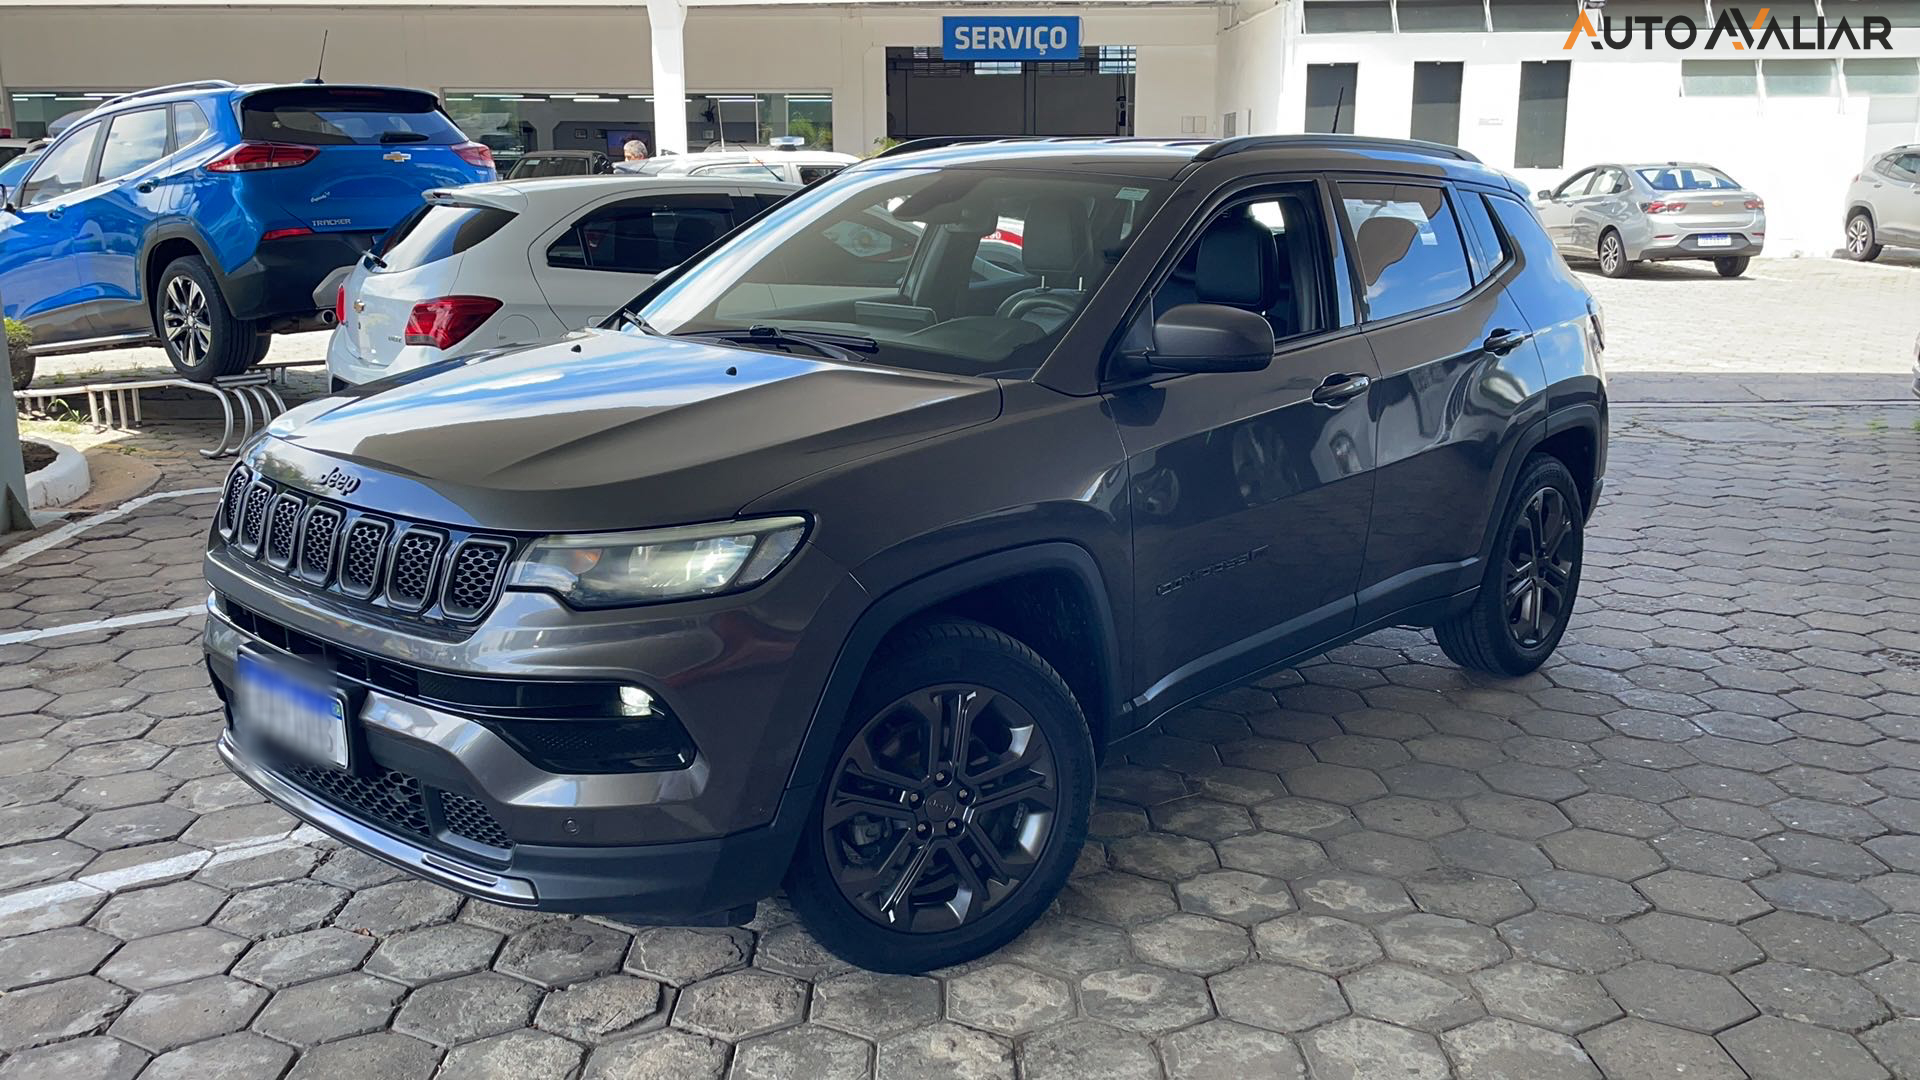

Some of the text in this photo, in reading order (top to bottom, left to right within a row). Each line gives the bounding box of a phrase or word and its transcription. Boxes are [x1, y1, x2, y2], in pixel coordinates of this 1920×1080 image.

[954, 25, 1068, 55] SERVIÇO
[311, 218, 352, 227] TRACKER
[320, 466, 362, 496] Jeep
